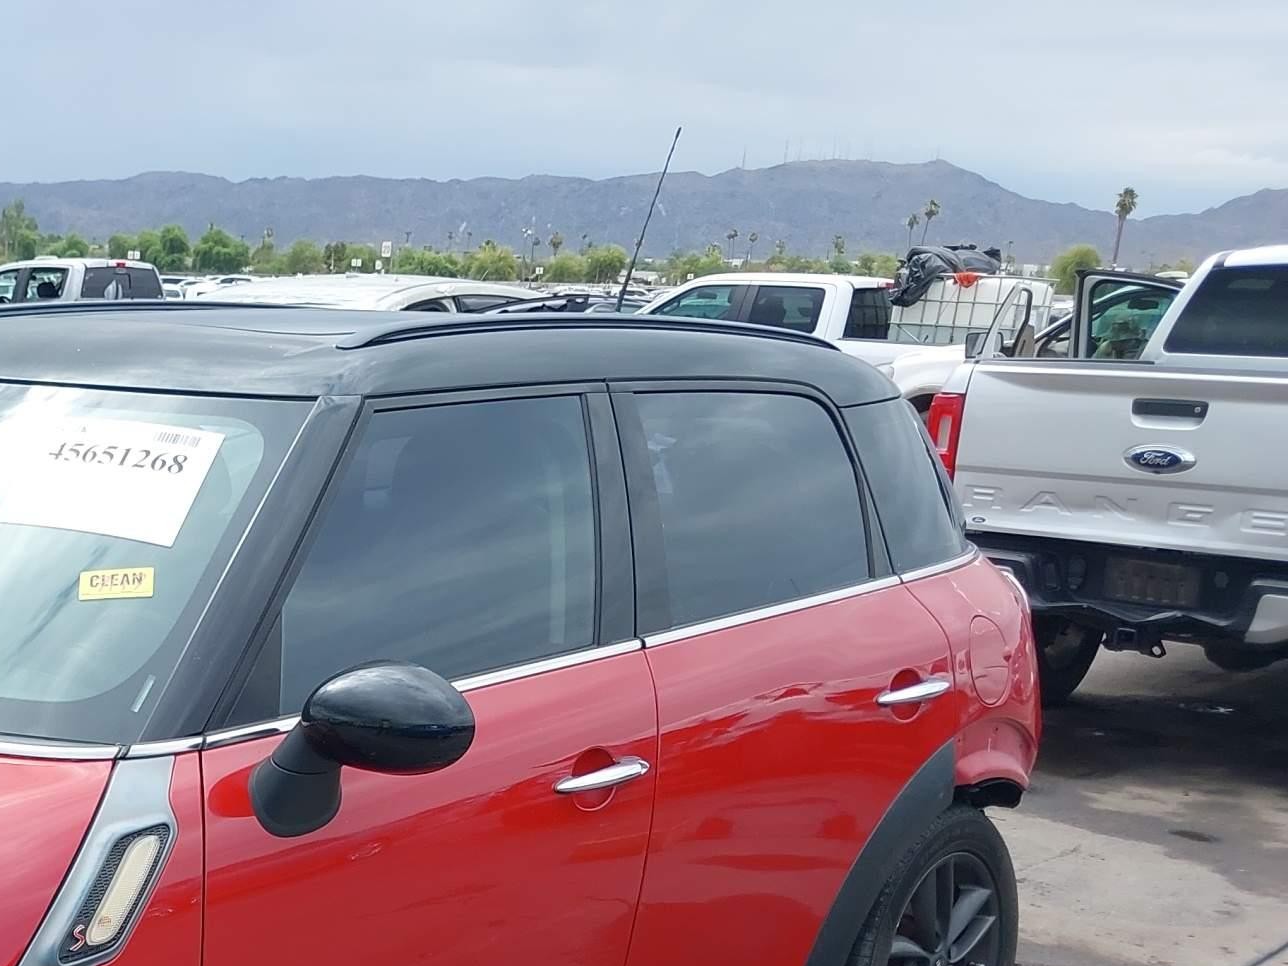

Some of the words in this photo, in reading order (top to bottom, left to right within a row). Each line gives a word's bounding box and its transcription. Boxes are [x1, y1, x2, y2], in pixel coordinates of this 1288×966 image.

[49, 442, 188, 474] 45651268
[1140, 451, 1171, 467] Ford
[89, 571, 144, 588] CLEAN
[69, 924, 86, 952] S
